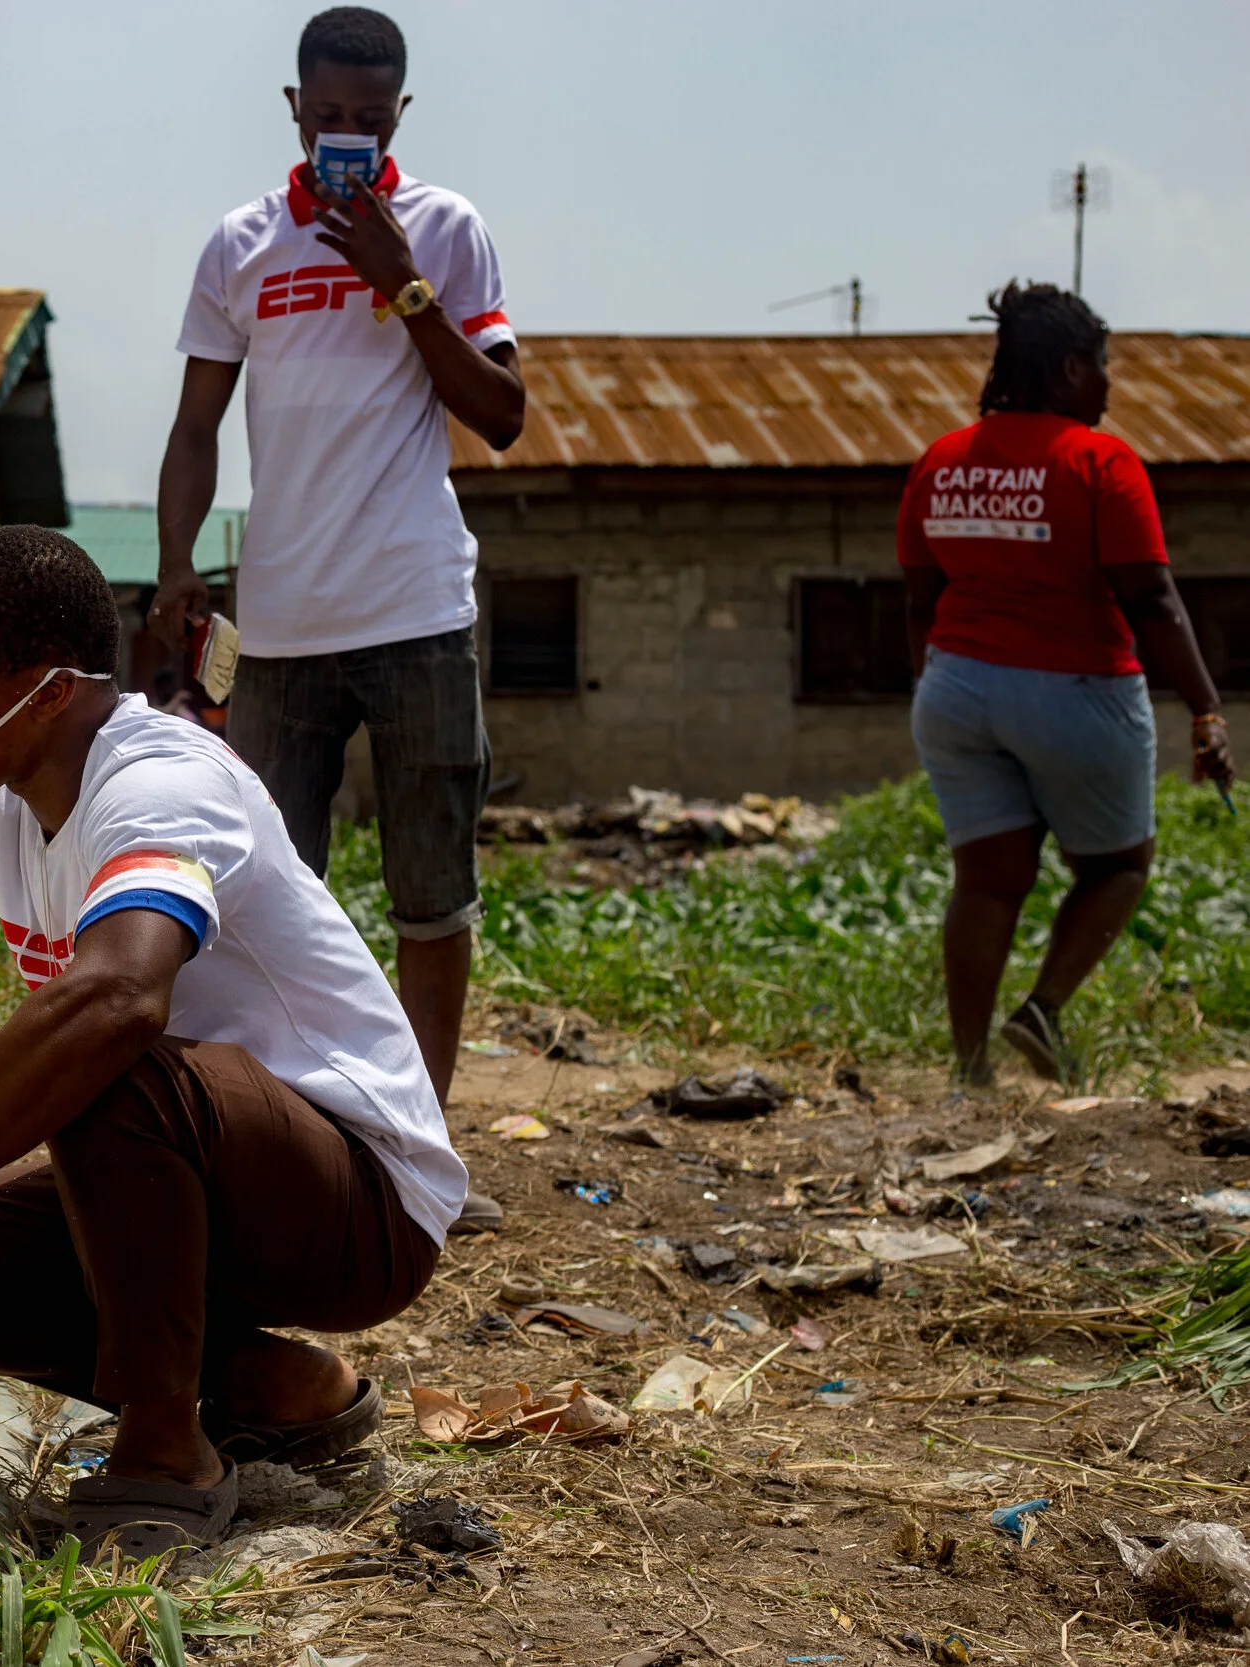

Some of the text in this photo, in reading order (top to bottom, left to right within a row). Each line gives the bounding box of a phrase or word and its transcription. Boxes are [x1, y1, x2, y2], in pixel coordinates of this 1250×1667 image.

[257, 264, 391, 320] ESP
[933, 466, 1047, 491] CAPTAIN
[930, 493, 1045, 519] MAKOKO
